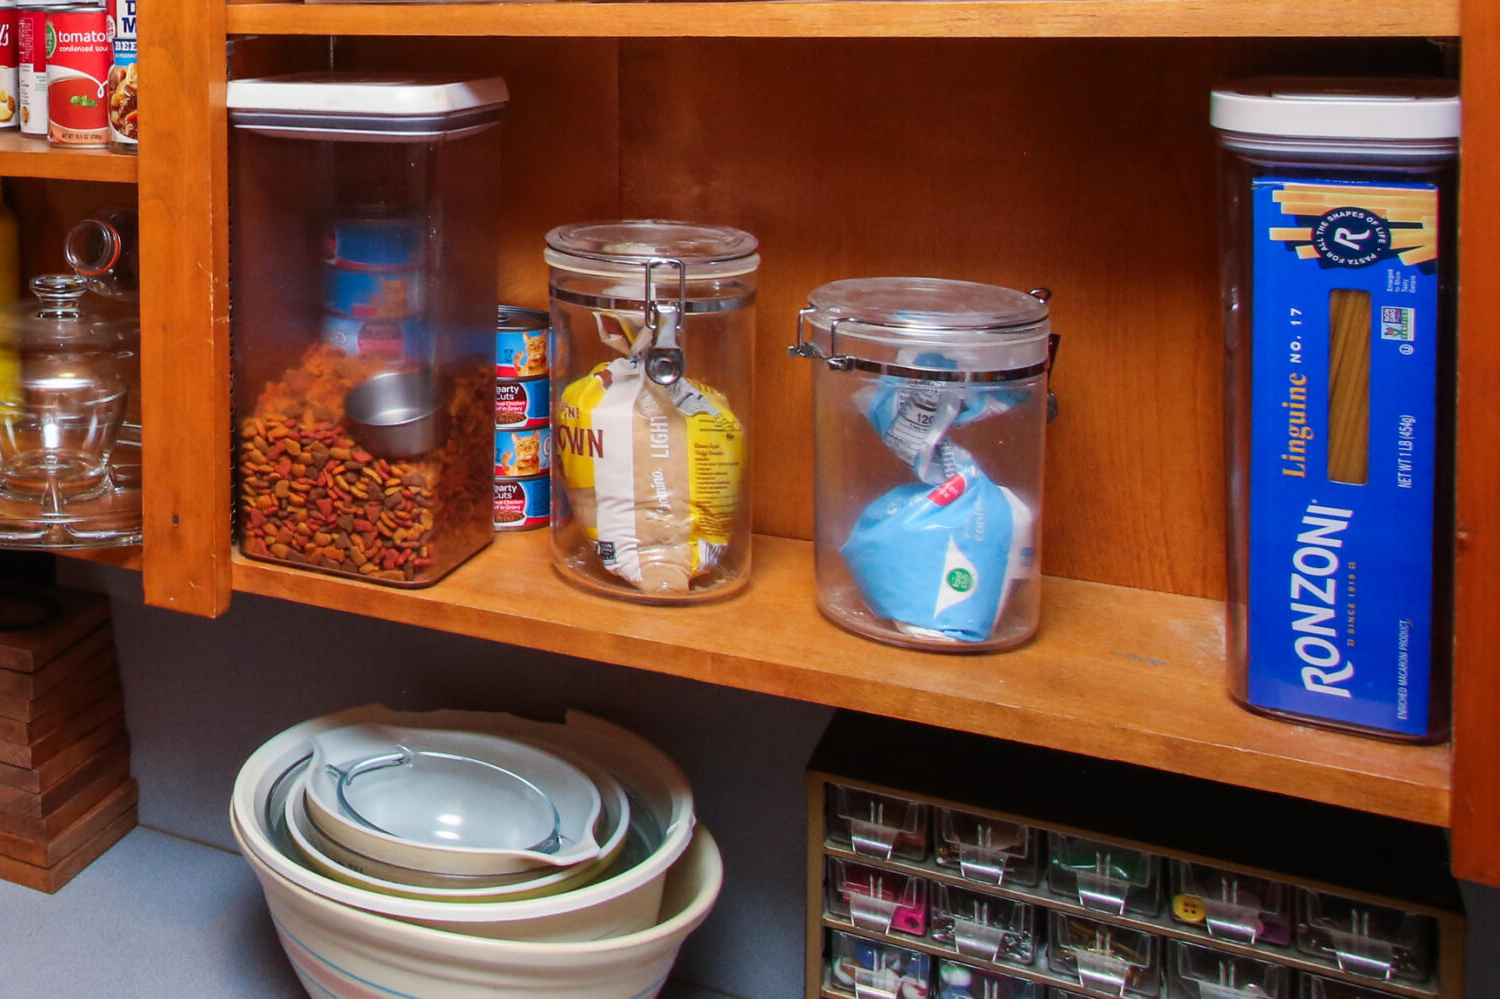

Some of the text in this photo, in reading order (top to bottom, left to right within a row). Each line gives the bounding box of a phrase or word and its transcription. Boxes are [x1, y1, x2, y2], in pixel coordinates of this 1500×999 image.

[59, 31, 106, 43] tomato
[1326, 210, 1365, 222] SHAPES
[1366, 216, 1379, 226] OF
[1316, 220, 1329, 235] THE
[1375, 226, 1386, 244] LIFE
[1334, 227, 1371, 251] R
[1326, 251, 1345, 264] FOR
[1347, 253, 1377, 265] PASTA
[1281, 307, 1315, 478] Linguine NO. 17
[1398, 440, 1413, 451] LB
[1398, 458, 1412, 473] WT
[1398, 473, 1412, 489] NET
[1290, 504, 1354, 698] RONZONI
